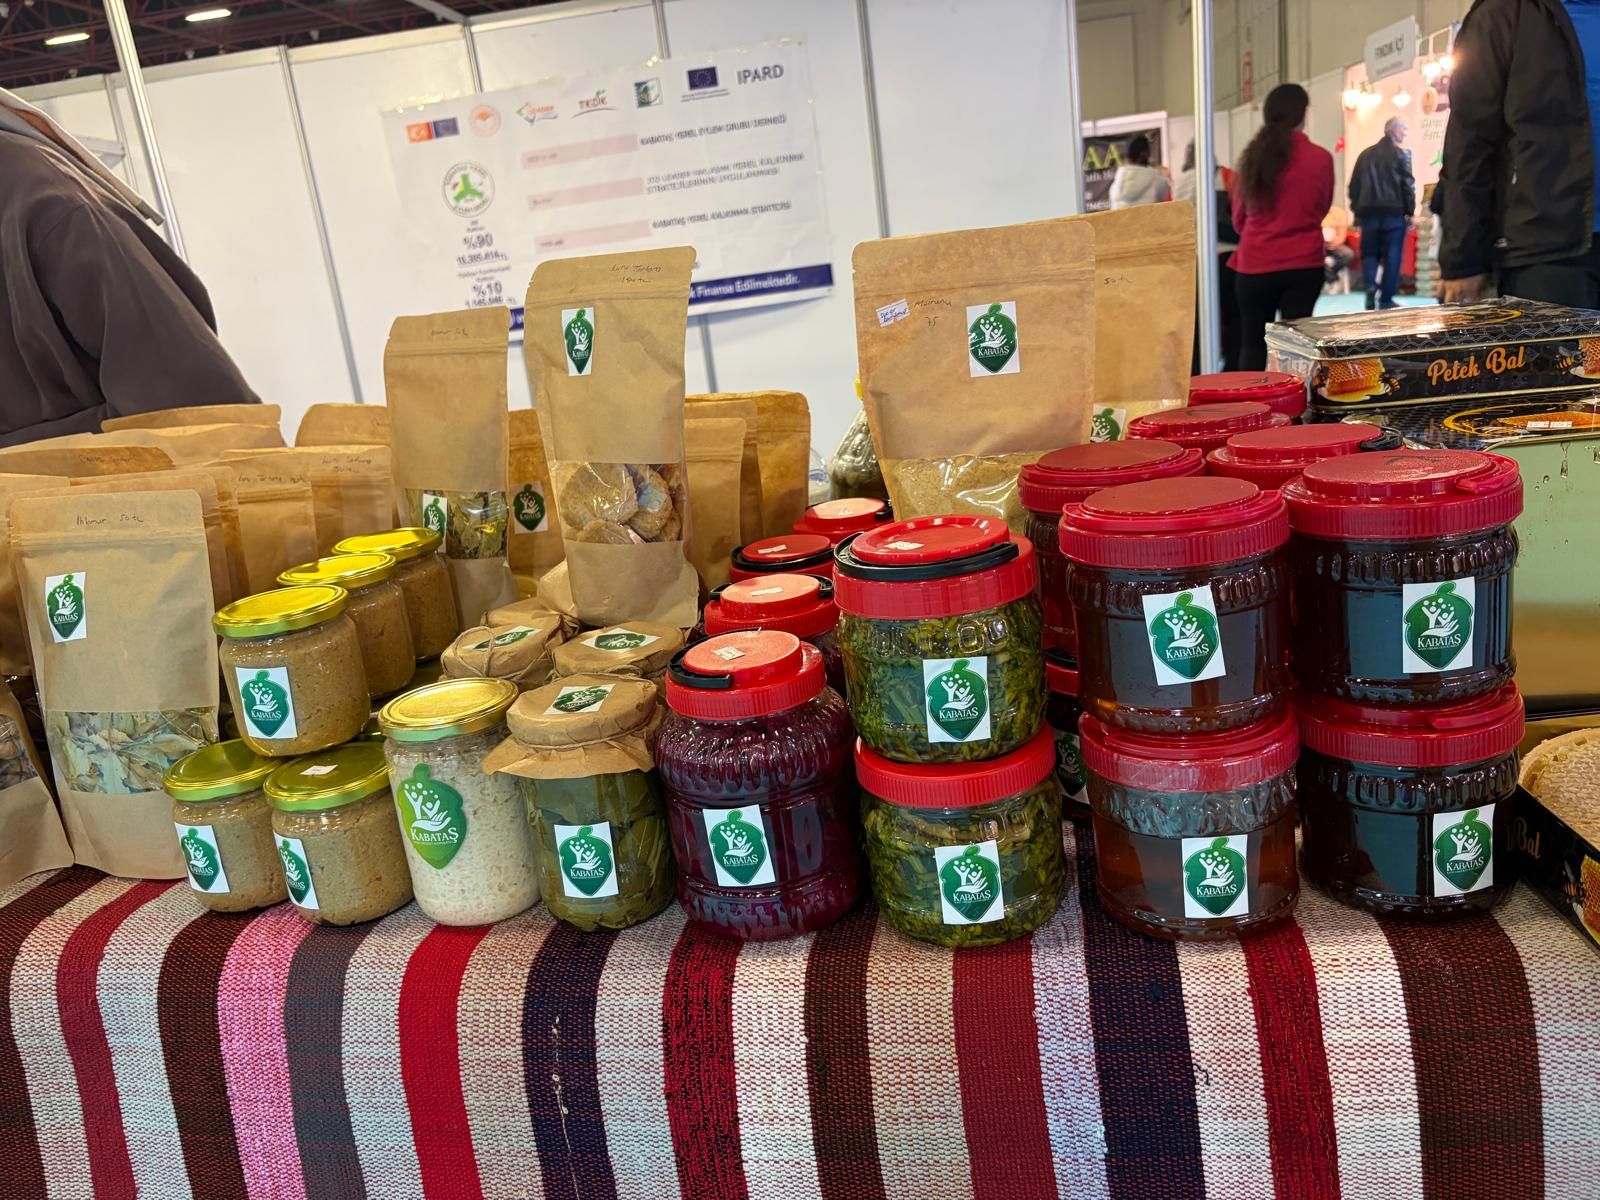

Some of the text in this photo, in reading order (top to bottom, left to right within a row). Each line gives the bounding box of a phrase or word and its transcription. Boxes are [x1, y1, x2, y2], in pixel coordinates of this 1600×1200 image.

[736, 64, 785, 85] IPARD
[1427, 345, 1526, 386] Petek Bal
[410, 827, 460, 844] KABATAŞ
